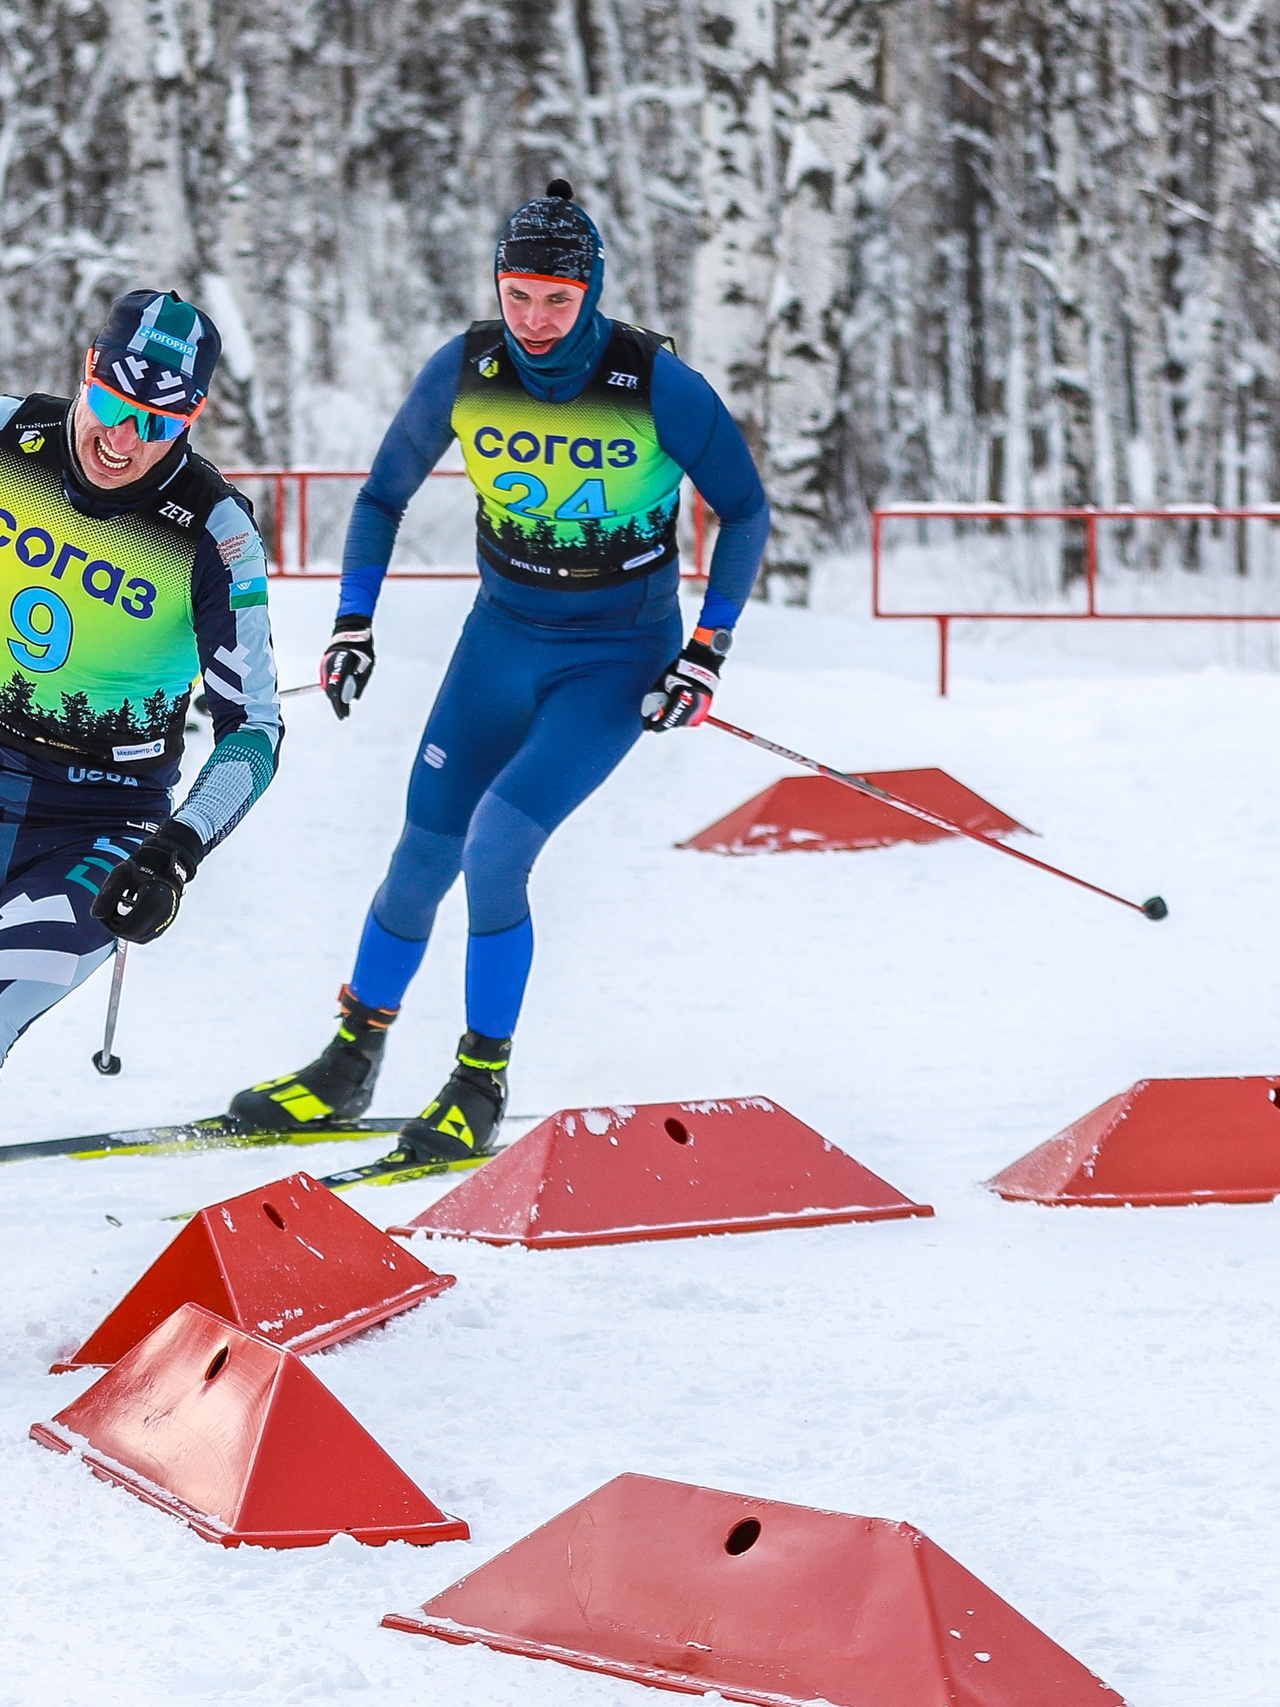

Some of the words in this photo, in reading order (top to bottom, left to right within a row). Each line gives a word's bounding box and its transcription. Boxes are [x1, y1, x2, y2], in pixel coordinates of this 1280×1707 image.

[149, 330, 194, 356] ЮГОРИЯ
[493, 471, 618, 521] 24
[6, 585, 74, 674] 9
